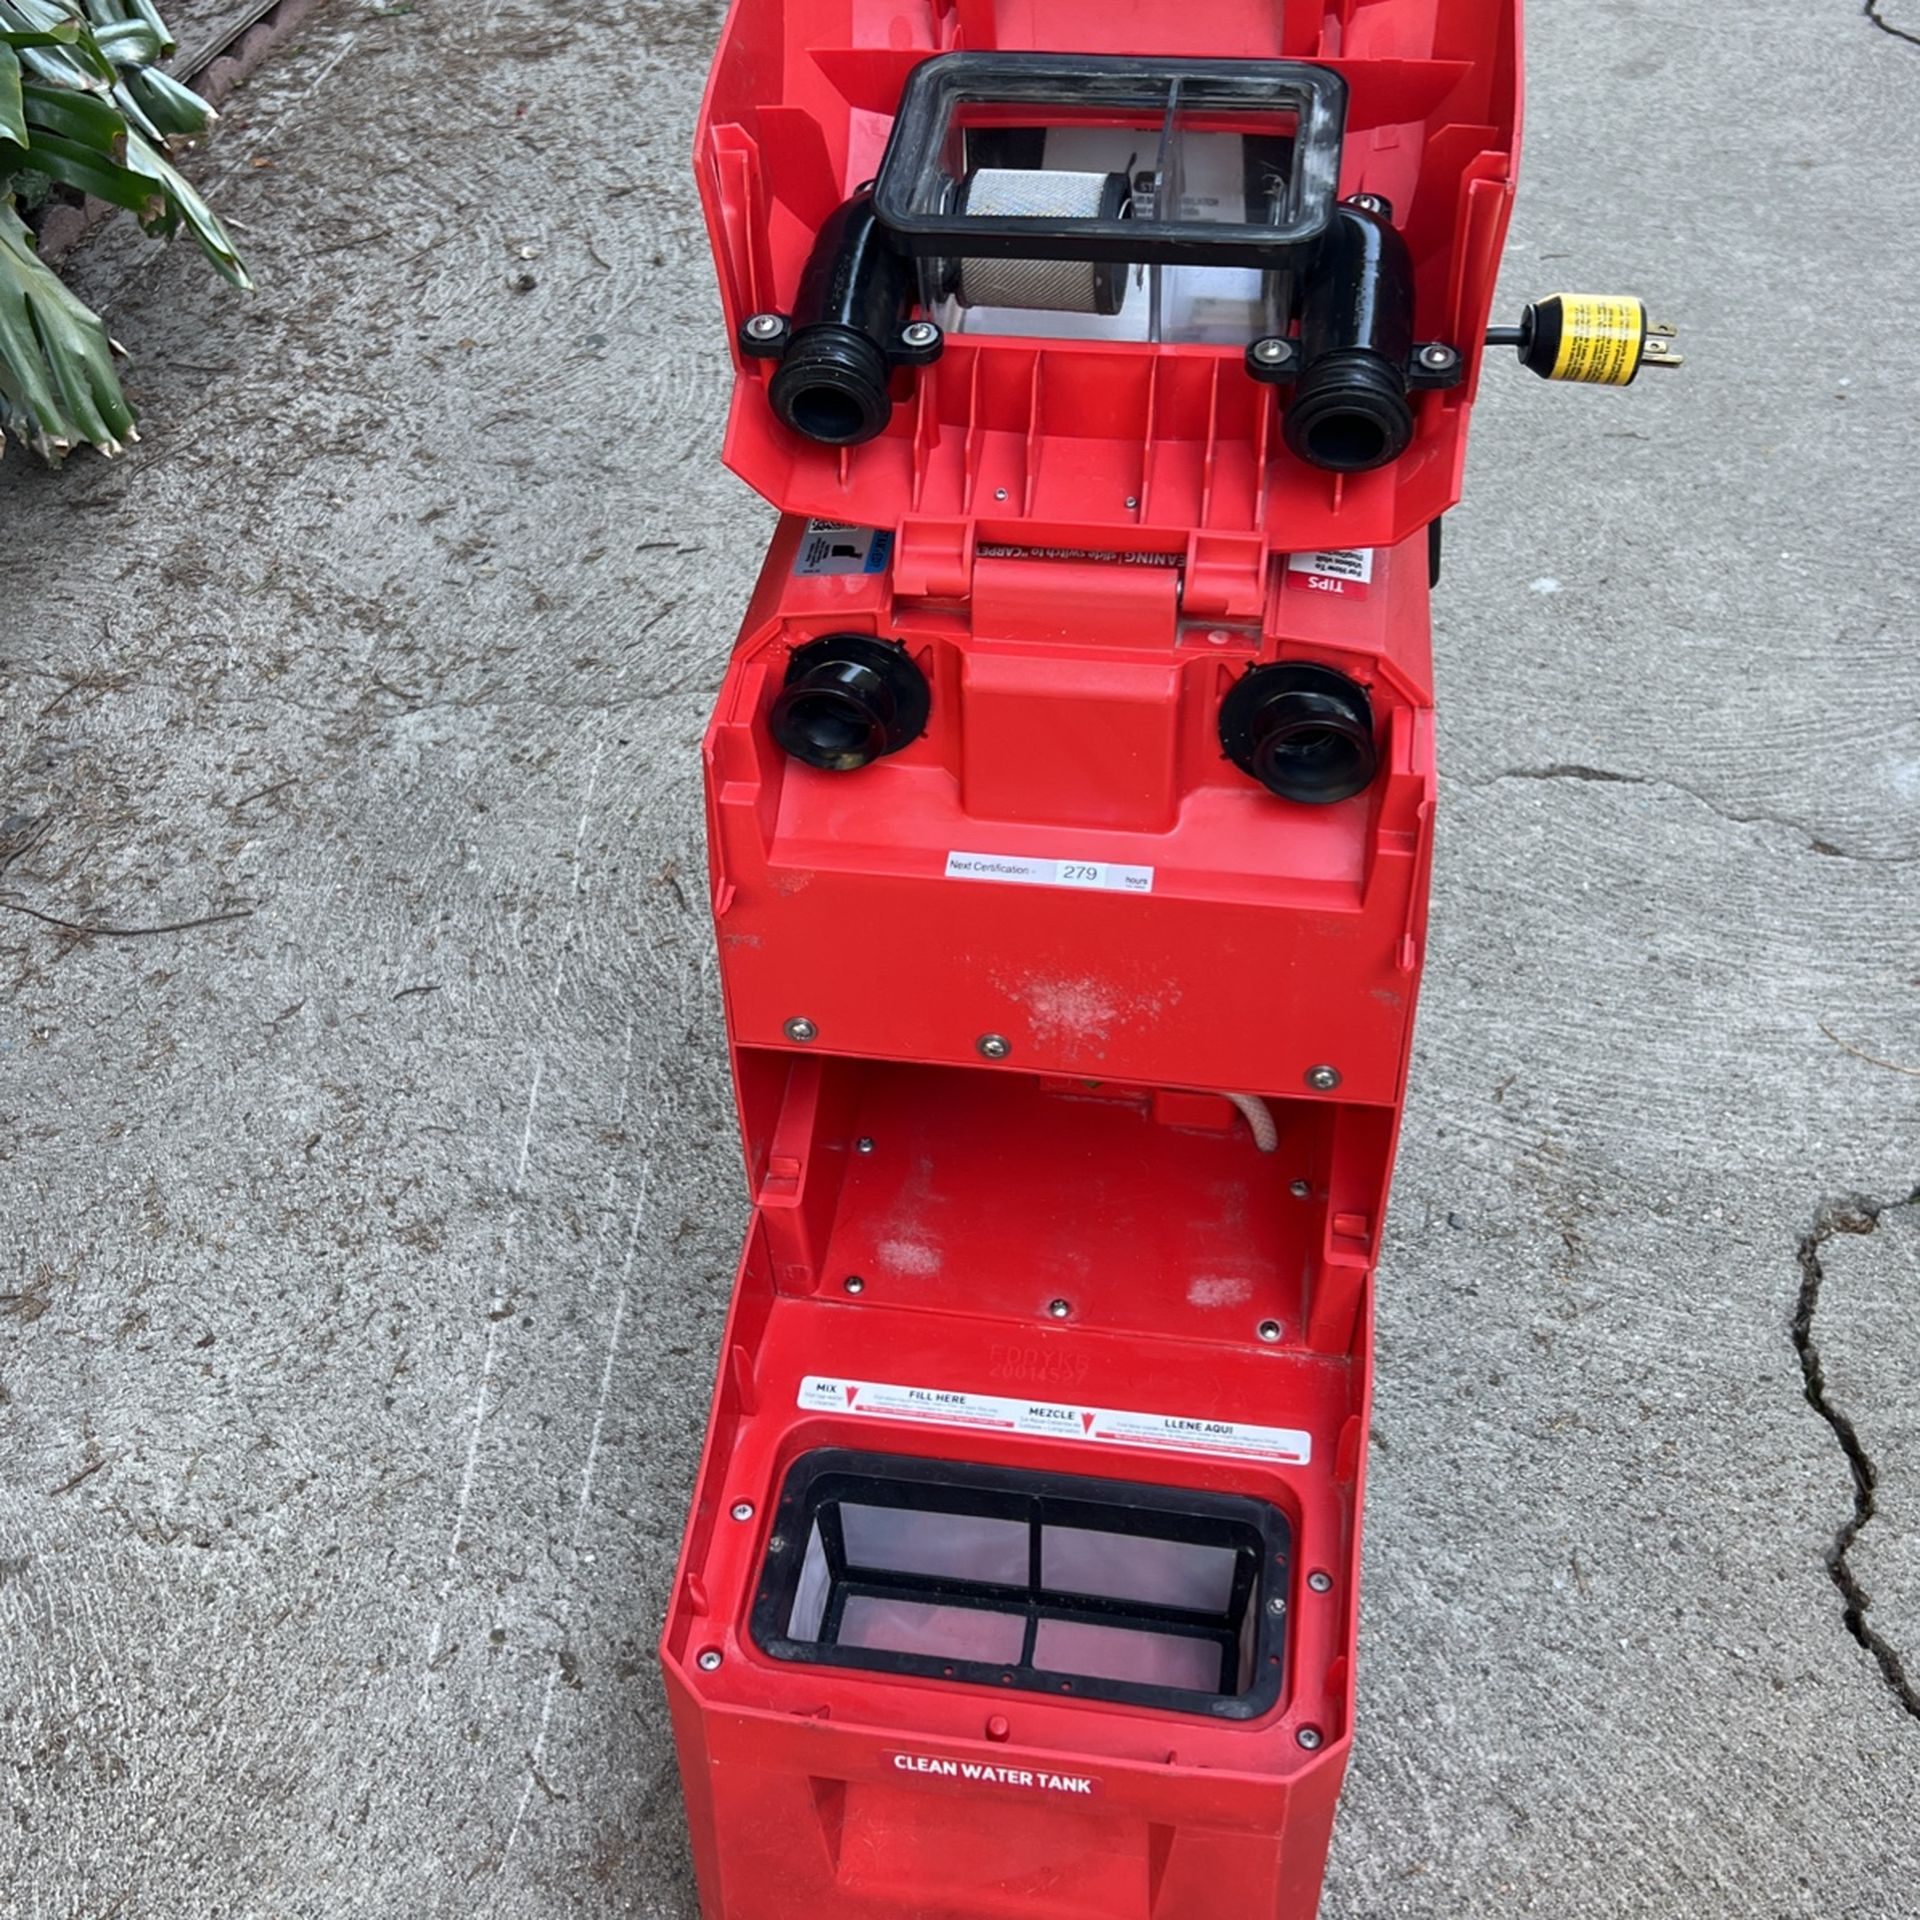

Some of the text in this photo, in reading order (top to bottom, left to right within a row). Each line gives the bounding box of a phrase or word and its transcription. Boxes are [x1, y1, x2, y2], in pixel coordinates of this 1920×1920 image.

[1308, 576, 1344, 593] TIPS
[950, 859, 972, 871] Next
[973, 861, 1030, 876] Certification
[1063, 865, 1098, 881] 279
[1125, 875, 1148, 886] hours
[816, 1383, 838, 1393] MIX
[908, 1390, 933, 1401] FILL
[936, 1394, 966, 1405] HERE
[1029, 1407, 1076, 1420] MEZCLE
[1165, 1419, 1202, 1431] LLENE
[1205, 1423, 1234, 1435] AQUI
[894, 1755, 1092, 1794] CLEAN WATER TANK
